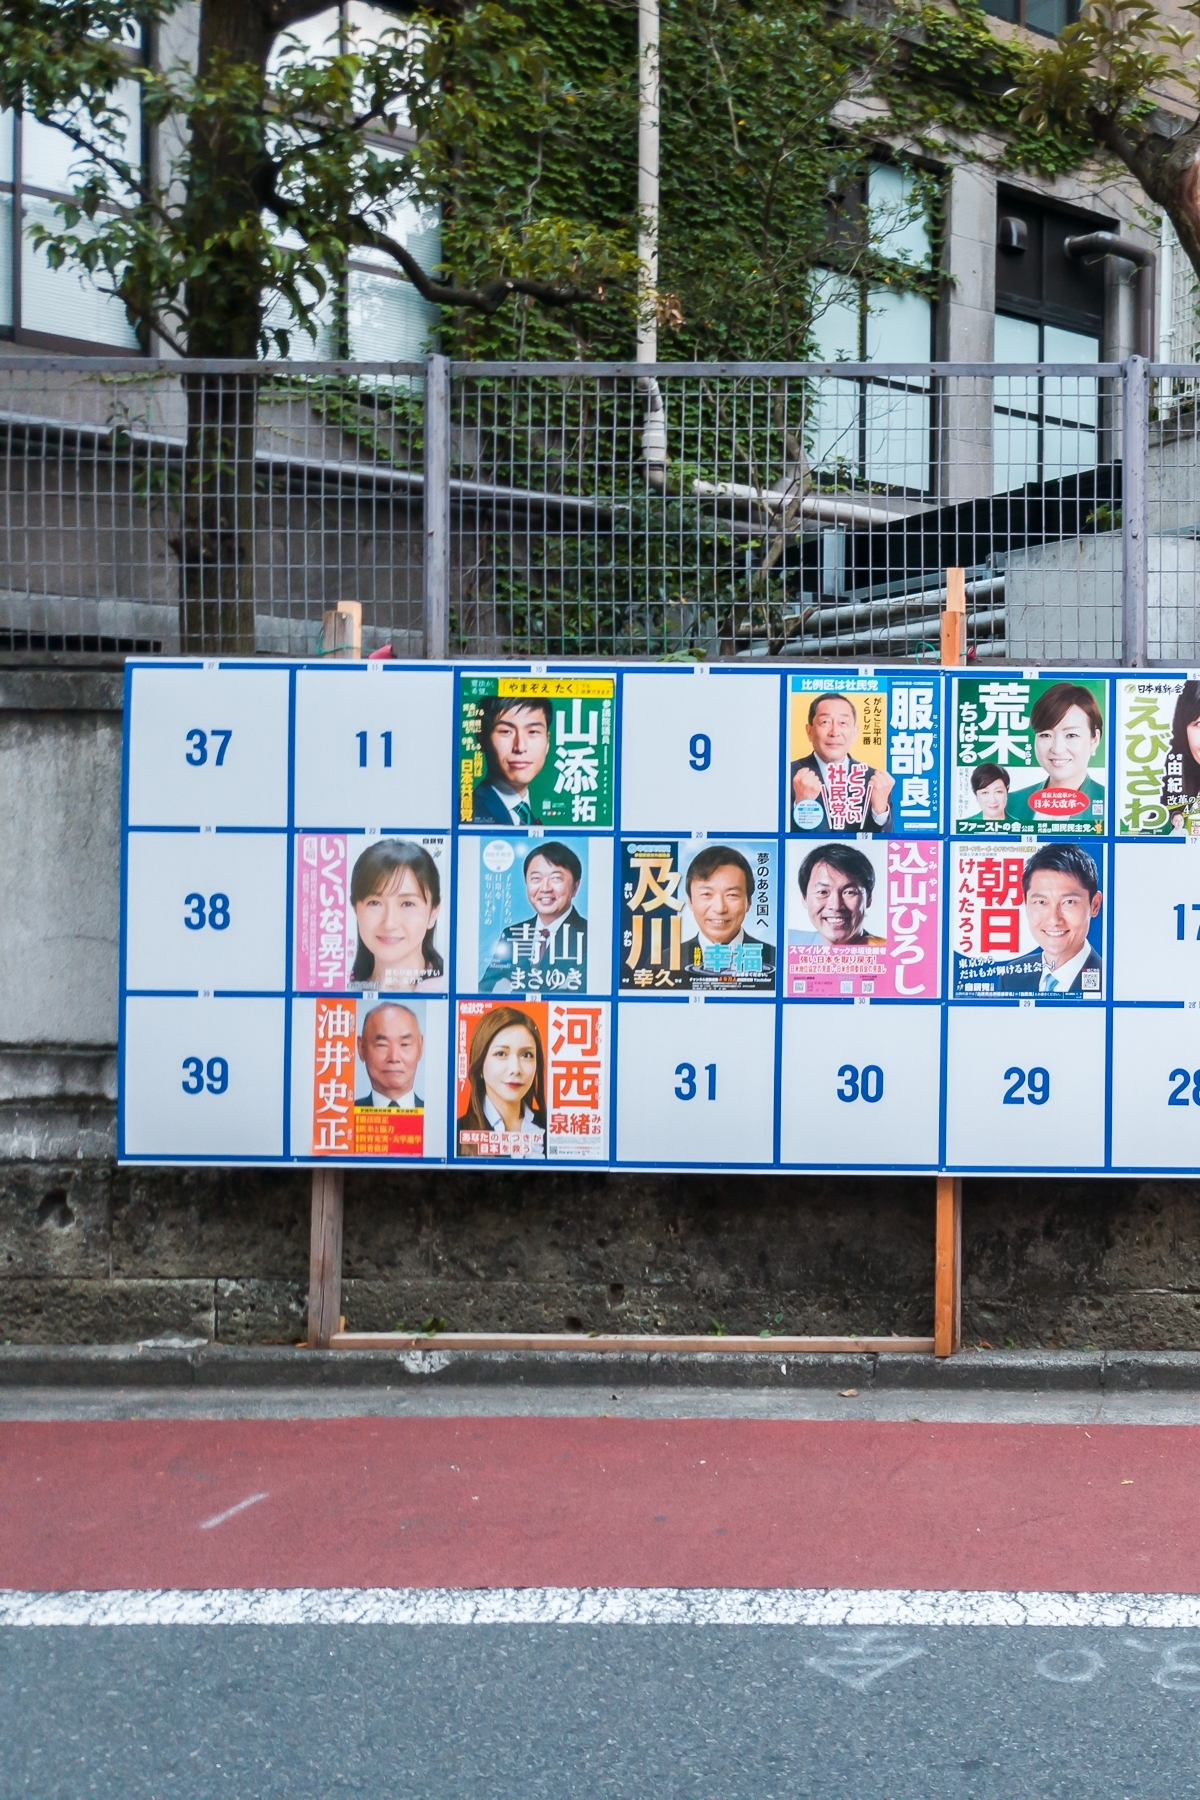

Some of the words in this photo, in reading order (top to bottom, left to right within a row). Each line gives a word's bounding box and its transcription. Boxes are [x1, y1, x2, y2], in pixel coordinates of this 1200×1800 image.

[802, 679, 878, 691] 比例区は社民党
[863, 697, 871, 745] くらしが一番
[873, 697, 882, 745] がんこに平和
[959, 701, 978, 764] ちはる
[977, 682, 1030, 765] 荒木
[186, 729, 232, 766] 37
[356, 731, 392, 767] 11
[553, 698, 599, 822] 山添拓
[689, 734, 711, 771] 9
[890, 687, 934, 817] 服部良一
[1124, 696, 1170, 831] えびさわ
[461, 759, 473, 822] 日本共産党
[848, 764, 866, 822] どっこい
[1167, 760, 1183, 793] 由紀
[1034, 799, 1086, 809] 日本大改革へ
[959, 821, 1022, 833] ファーストの会
[624, 882, 633, 899] おい
[756, 853, 770, 928] 夢のある国へ
[929, 846, 937, 902] こみやま
[184, 893, 230, 930] 38
[318, 836, 345, 988] いくいな晃子
[504, 873, 512, 924] 子どもたちの
[625, 857, 685, 971] 及川
[958, 858, 975, 953] けんたろう
[977, 857, 1025, 953] 朝日
[888, 842, 928, 995] 込山ひろし
[507, 923, 584, 965] 青山
[623, 930, 632, 947] かわ
[703, 943, 763, 973] 幸福
[789, 946, 830, 955] スマイル党
[510, 967, 582, 990] まさゆき
[633, 968, 675, 987] 幸久
[959, 956, 995, 969] 東京から
[182, 1056, 228, 1095] 39
[314, 1004, 350, 1150] 油井史正
[551, 1006, 602, 1110] 河西
[675, 1063, 716, 1100] 31
[837, 1064, 883, 1103] 30
[1003, 1067, 1049, 1105] 29
[461, 1133, 542, 1143] あなたの気づきが
[550, 1113, 591, 1135] 泉緒
[591, 1113, 601, 1134] みお
[479, 1144, 531, 1154] 日本を救う
